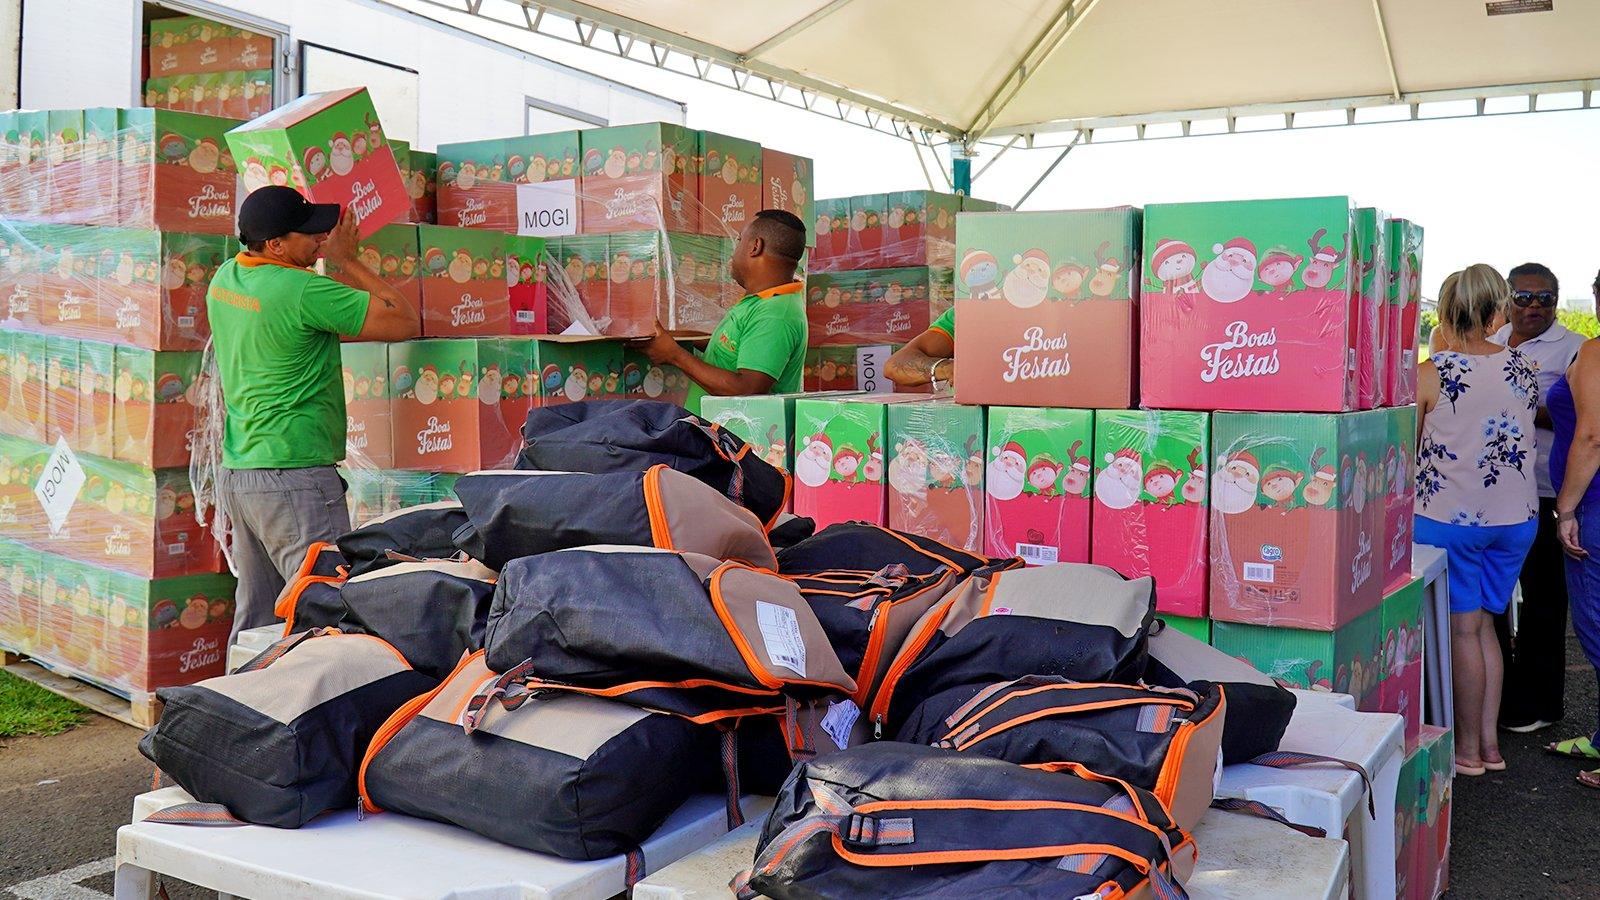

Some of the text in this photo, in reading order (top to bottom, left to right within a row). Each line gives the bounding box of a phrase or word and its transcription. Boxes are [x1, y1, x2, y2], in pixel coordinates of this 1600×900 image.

[200, 184, 230, 200] Boas
[352, 178, 375, 201] Boas
[188, 196, 231, 218] Festas
[525, 209, 569, 229] MOGI
[461, 293, 483, 309] Boas
[451, 304, 486, 327] Festas
[1022, 326, 1068, 353] Boas
[1223, 320, 1277, 350] Boas
[863, 353, 877, 392] MOG
[1002, 346, 1071, 383] Festas
[1200, 342, 1280, 382] Festas
[427, 416, 451, 434] Boas
[417, 429, 453, 455] Festas
[42, 450, 71, 503] MOGI
[193, 637, 219, 653] Boas
[180, 650, 220, 673] Festas
